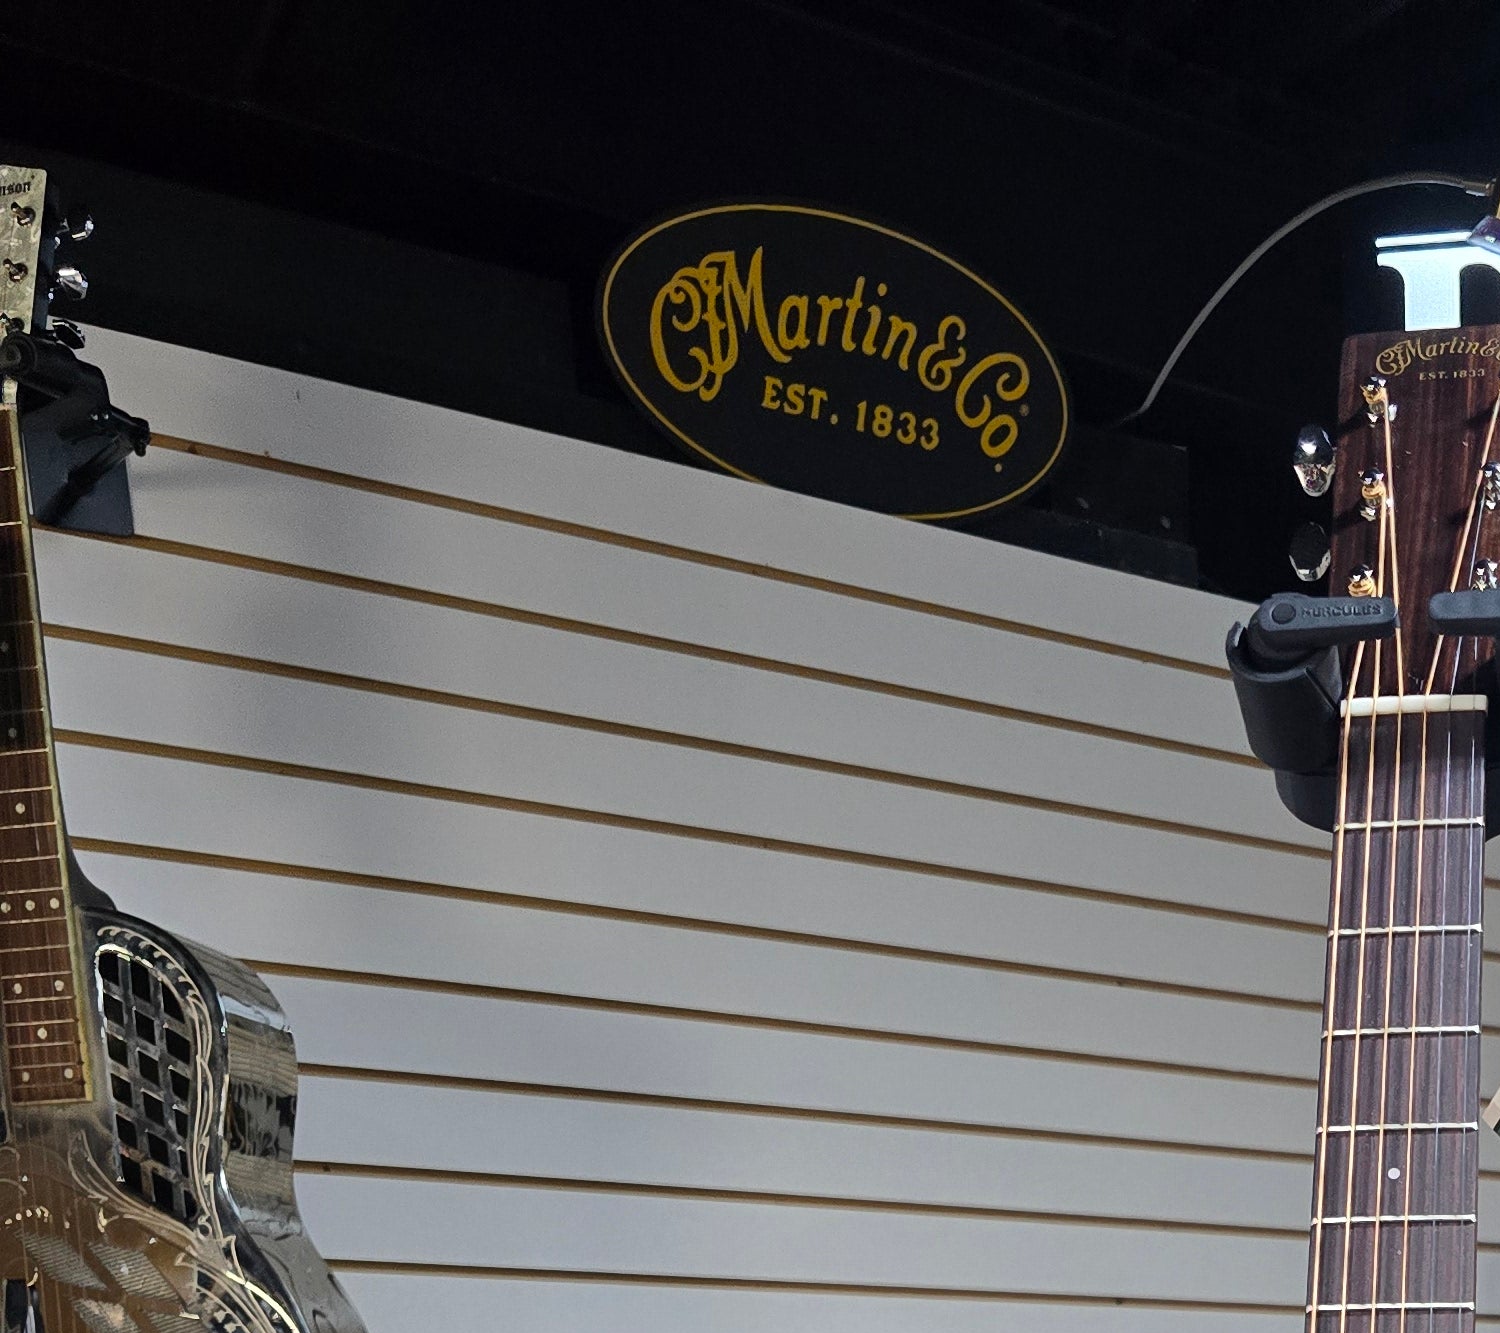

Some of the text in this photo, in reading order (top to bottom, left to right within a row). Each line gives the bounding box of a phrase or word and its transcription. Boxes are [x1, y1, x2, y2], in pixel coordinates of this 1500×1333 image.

[1452, 368, 1486, 379] 1833
[762, 376, 940, 450] EST. 1833
